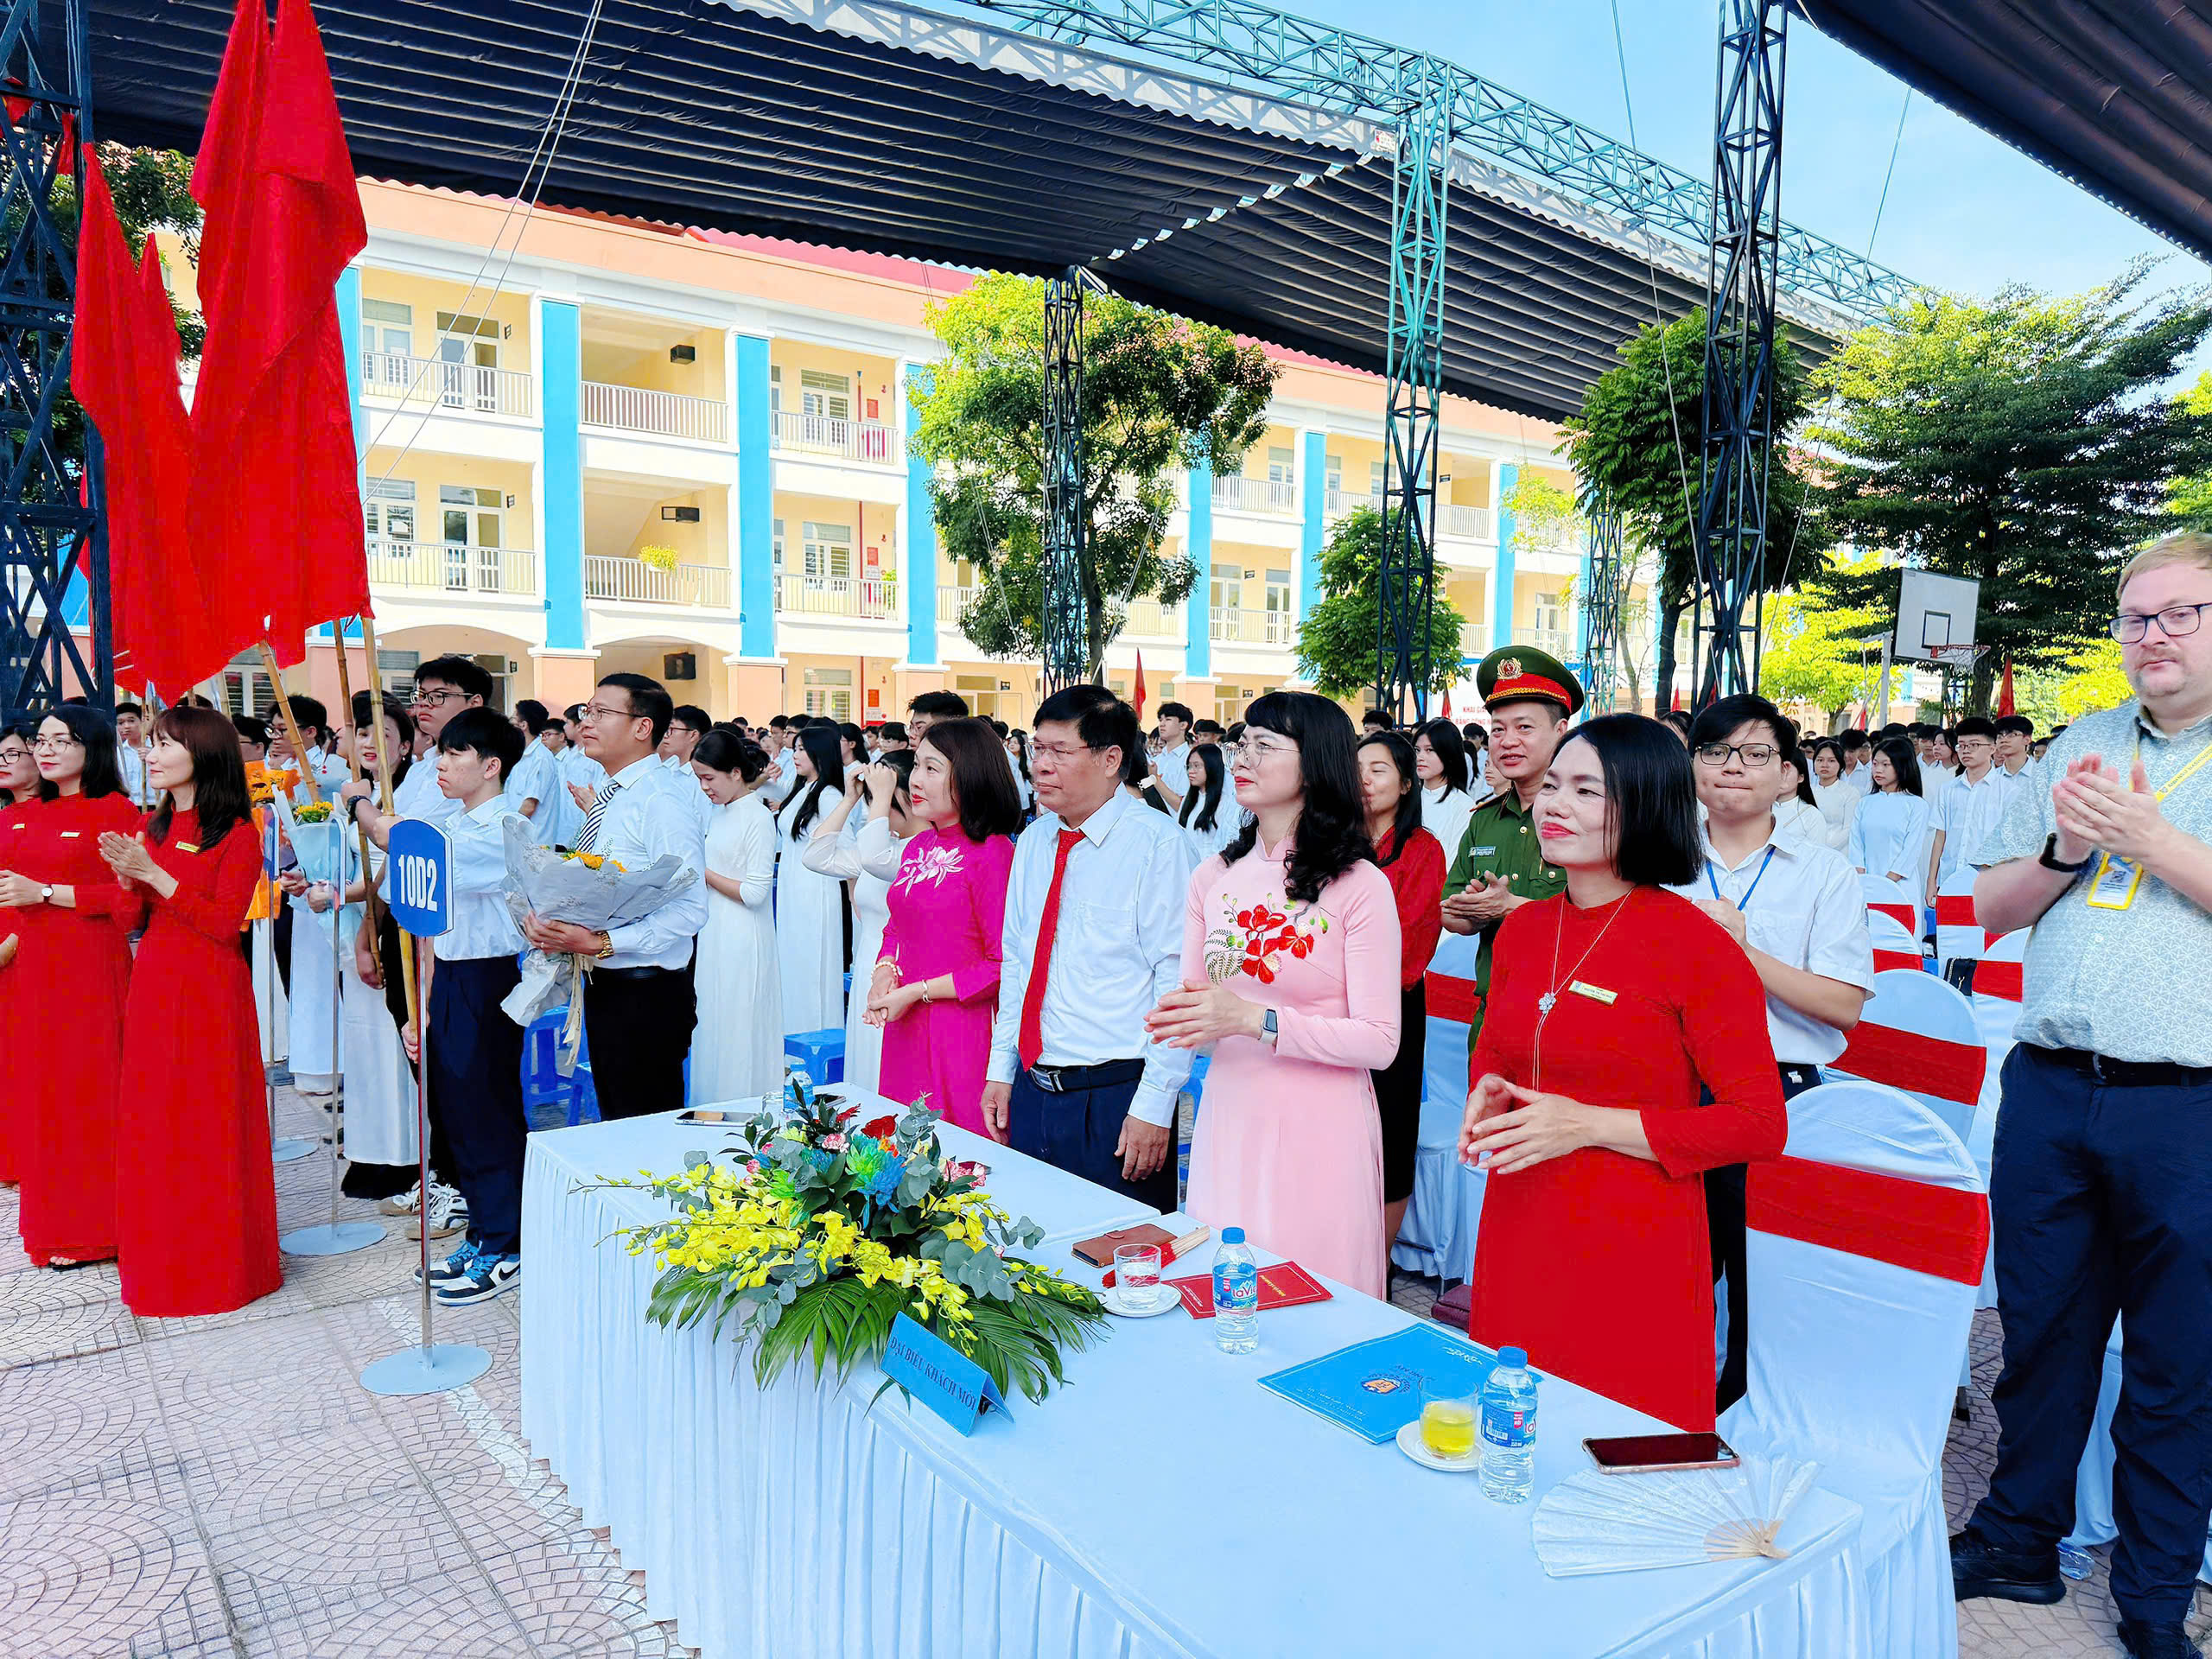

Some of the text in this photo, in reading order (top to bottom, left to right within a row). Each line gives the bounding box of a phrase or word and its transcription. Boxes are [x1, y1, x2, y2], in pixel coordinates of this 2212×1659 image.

[398, 855, 437, 912] 10D2
[890, 1337, 906, 1356] ĐẠI
[925, 1363, 957, 1395] KHÁCH
